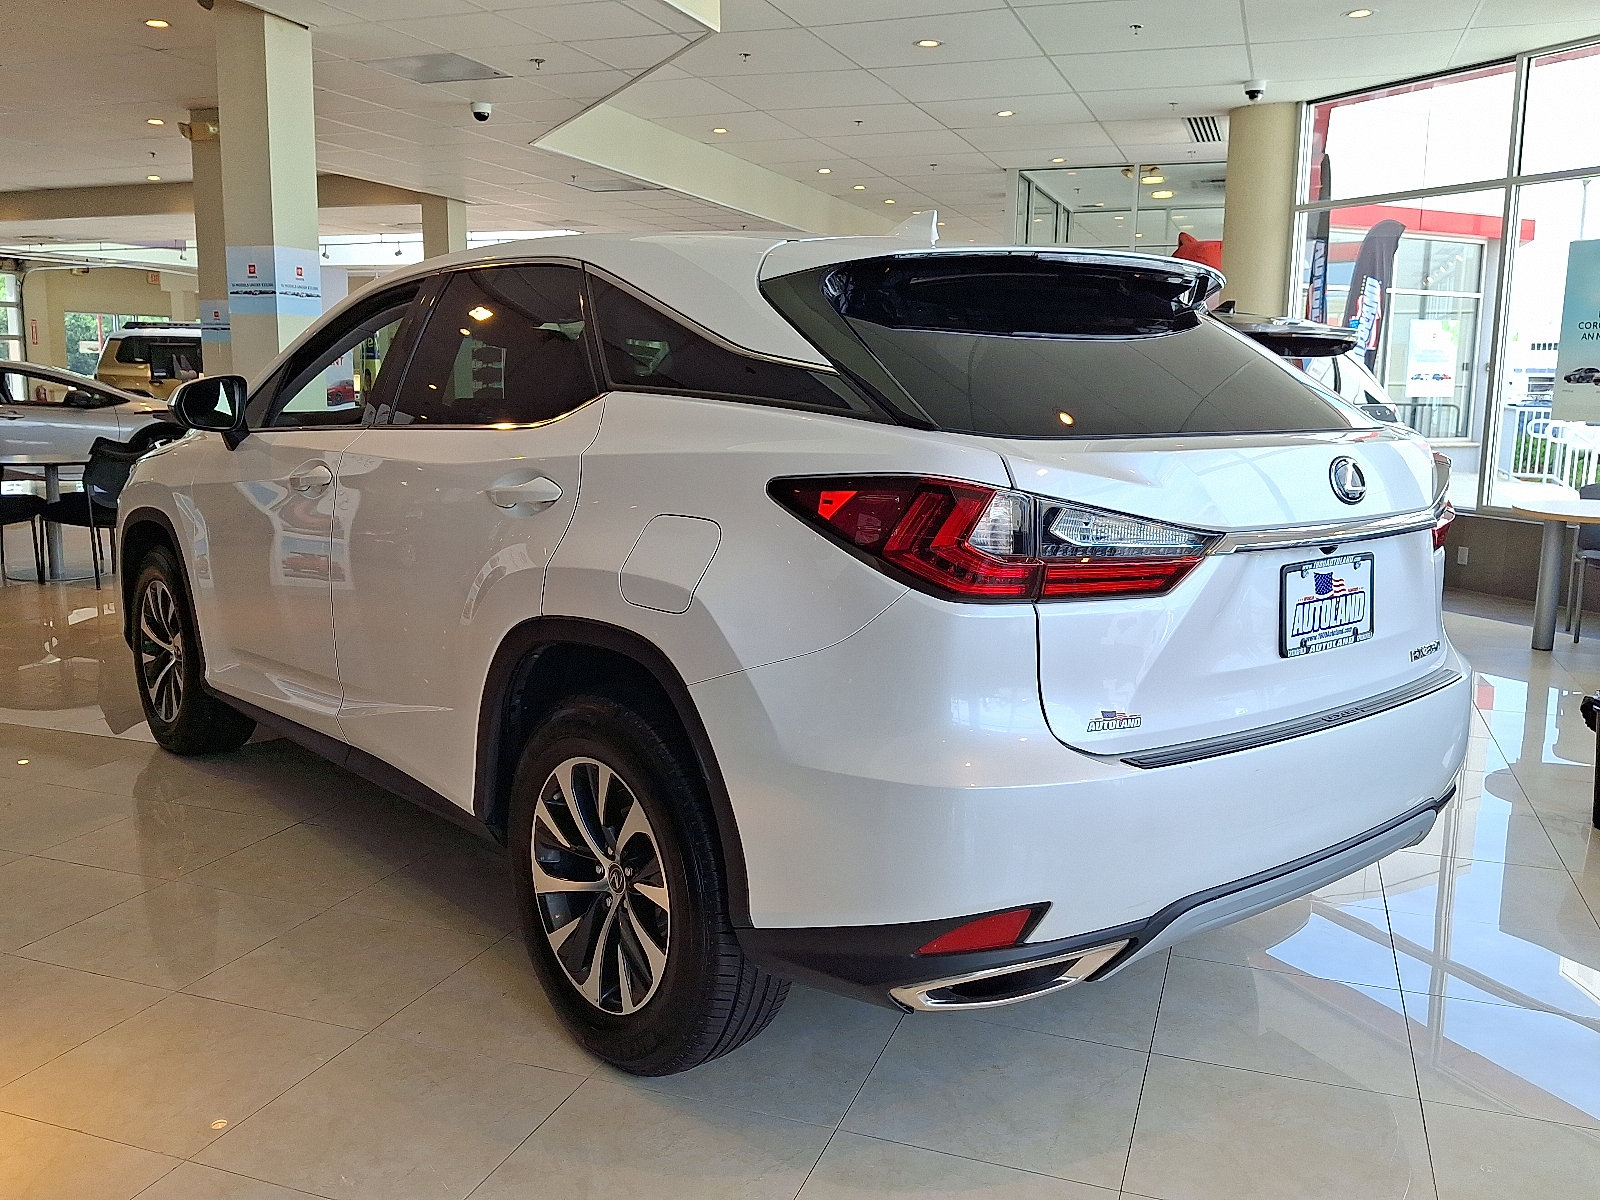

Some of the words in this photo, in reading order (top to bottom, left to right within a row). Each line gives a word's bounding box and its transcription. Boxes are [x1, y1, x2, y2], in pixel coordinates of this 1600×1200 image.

[1291, 591, 1365, 637] AUTOLAND
[1309, 635, 1355, 654] AUTOLAND
[1087, 716, 1142, 733] AUTOLAND
